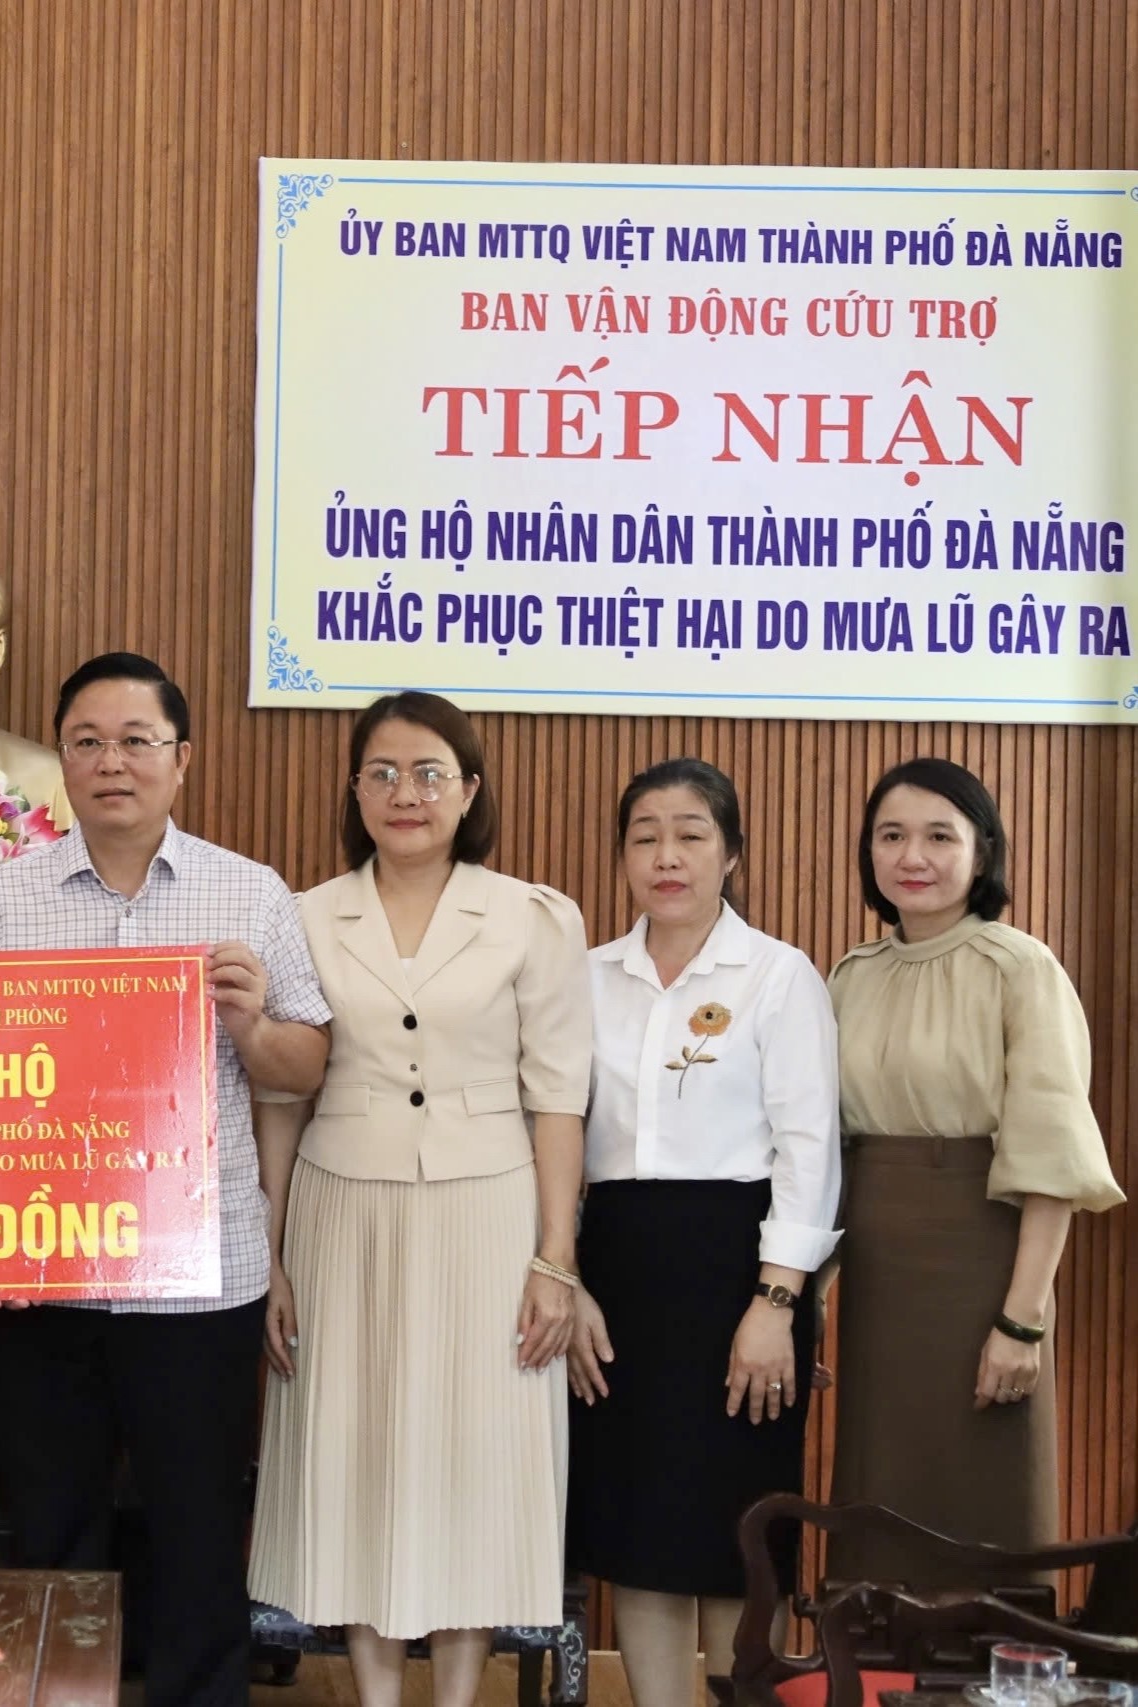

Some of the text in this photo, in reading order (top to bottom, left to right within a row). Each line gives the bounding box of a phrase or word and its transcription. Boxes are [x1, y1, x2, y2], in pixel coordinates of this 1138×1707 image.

[340, 208, 1123, 272] ỦY BAN MTTQ VIỆT NAM THÀNH PHỐ ĐÀ NẴNG
[461, 285, 999, 347] BAN VẬN ĐỘNG CỨU TRỢ
[422, 356, 1033, 488] TIẾP NHẬN
[325, 491, 1124, 574] ỦNG HỘ NHÂN DÂN THÀNH PHỐ ĐÀ NẴNG
[316, 572, 1130, 661] KHẮC PHỤC THIỆT HẠI DO MƯA LŨ GÂY RA
[3, 979, 39, 997] BAN
[43, 978, 96, 998] MTTQ
[100, 973, 142, 998] VIỆT
[146, 975, 188, 993] NAM
[4, 1003, 68, 1026] PHÒNG
[37, 1118, 66, 1140] ĐÀ
[71, 1113, 130, 1141] NẴNG
[19, 1150, 67, 1171] MƯA
[73, 1148, 100, 1170] LŨ
